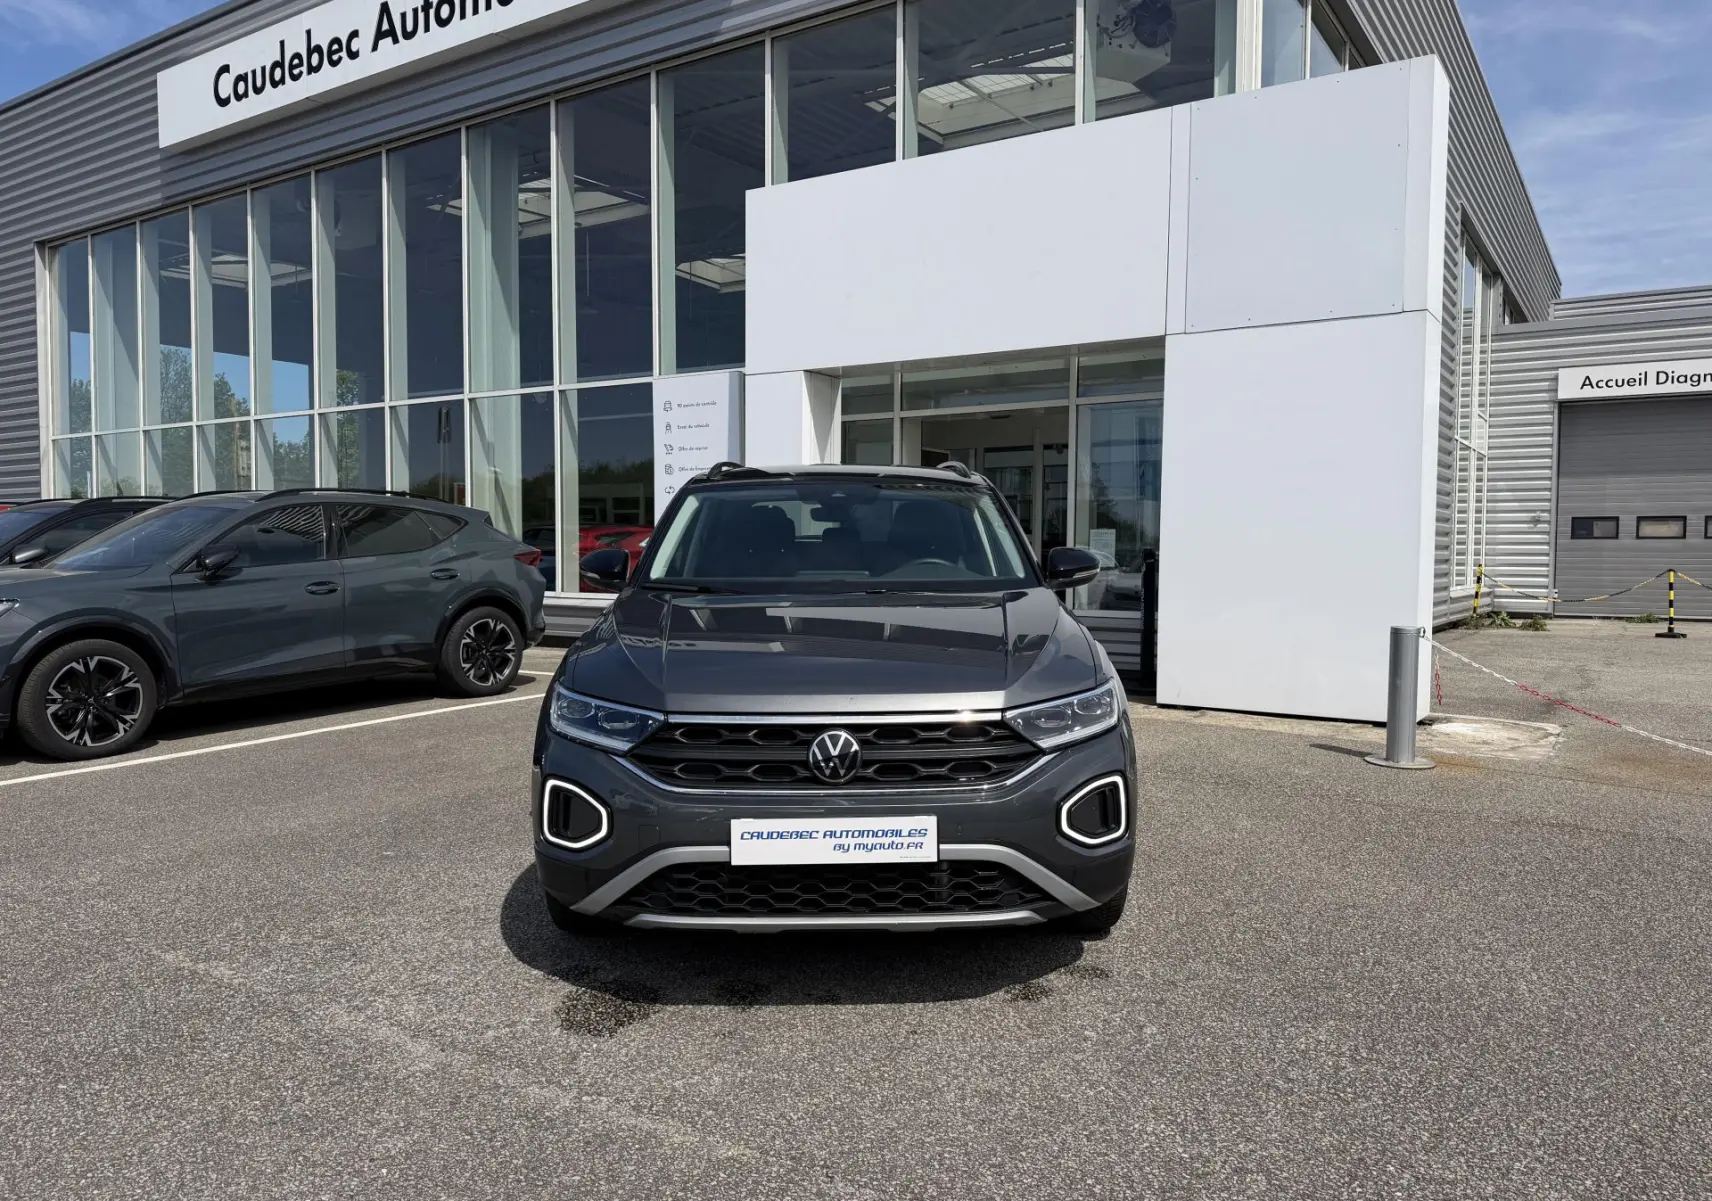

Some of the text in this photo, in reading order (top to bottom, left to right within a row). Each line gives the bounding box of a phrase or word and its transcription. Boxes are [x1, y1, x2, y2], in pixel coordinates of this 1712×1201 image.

[213, 0, 514, 108] Caudebec Autom
[1579, 370, 1648, 390] Accueil
[810, 730, 861, 782] VW
[740, 828, 929, 841] CAUDEBEC AUTOMOBILES
